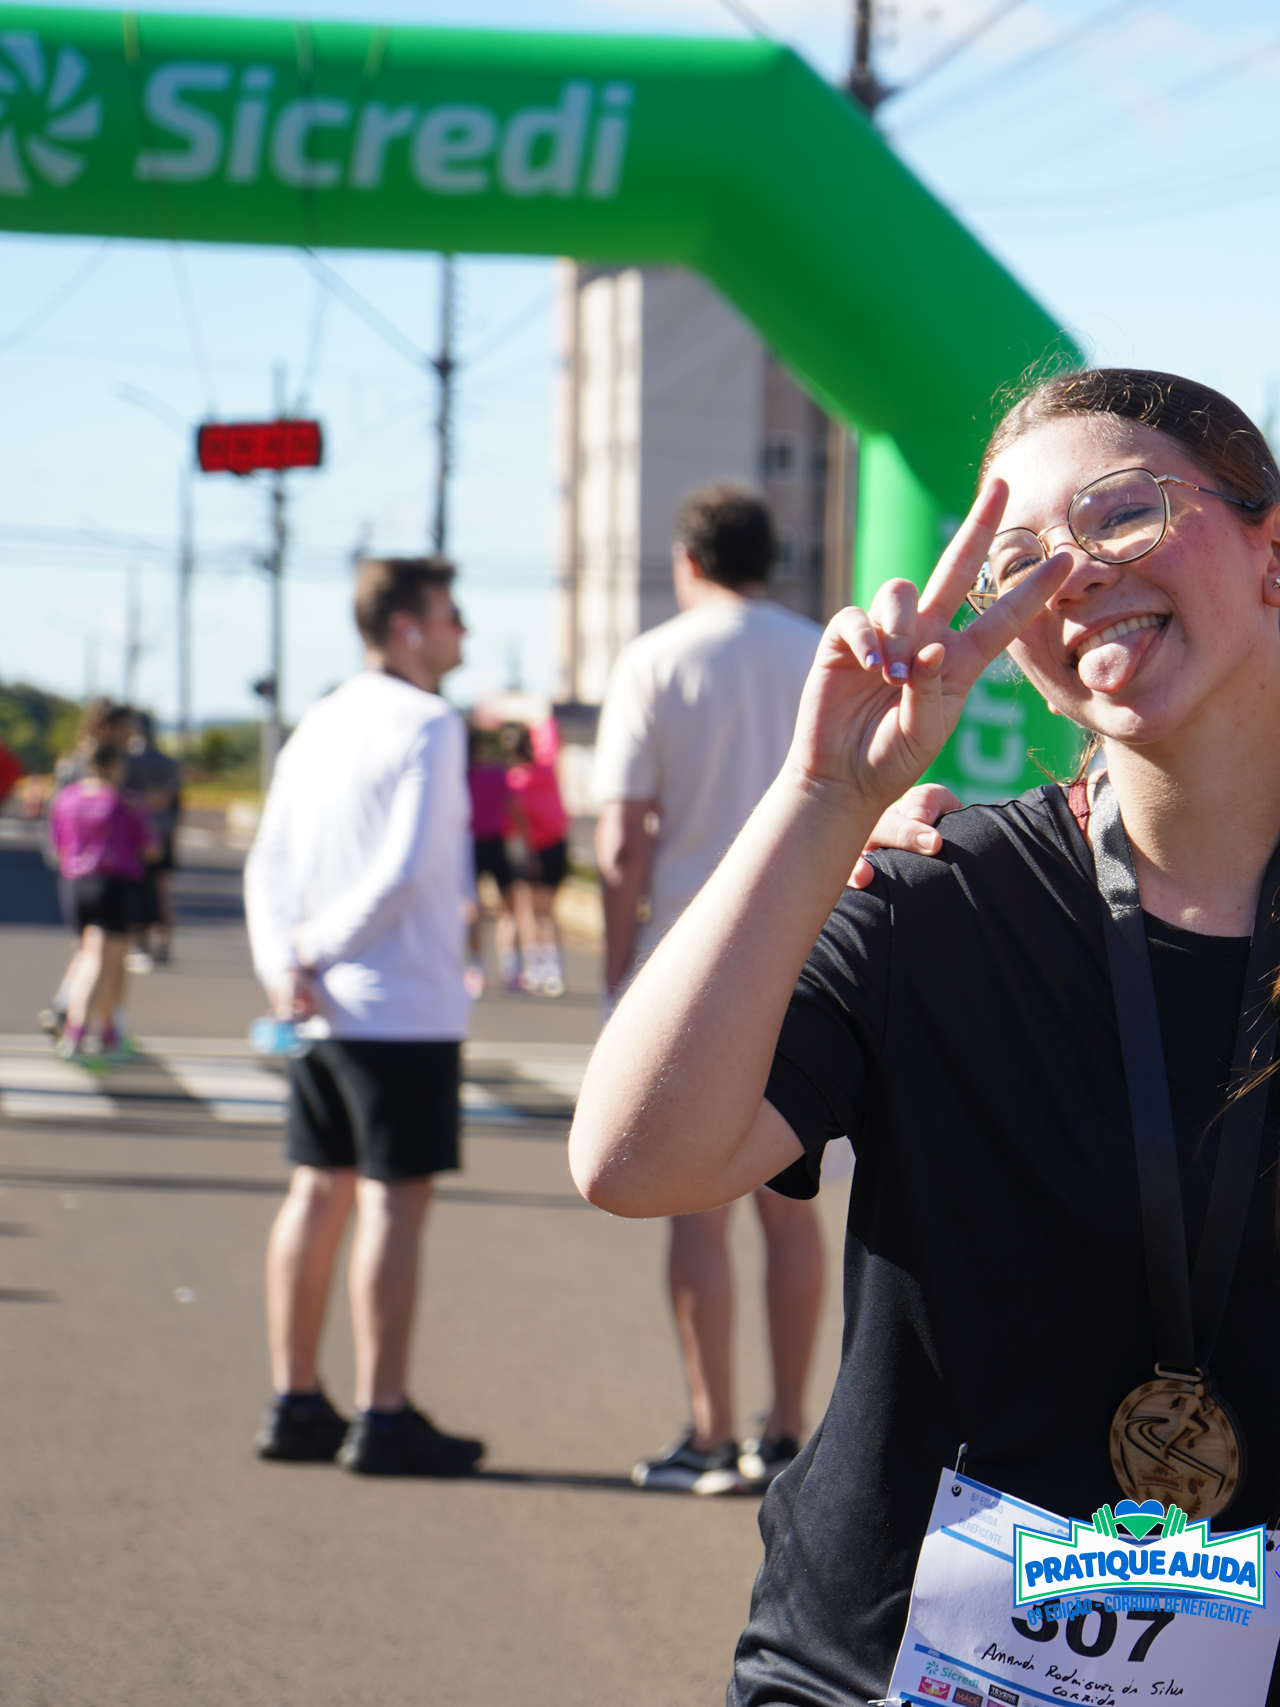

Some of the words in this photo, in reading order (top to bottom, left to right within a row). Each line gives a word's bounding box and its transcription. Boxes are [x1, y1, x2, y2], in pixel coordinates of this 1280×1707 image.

[135, 62, 635, 199] Sicredi
[979, 1495, 1004, 1514] EDIÇÃO
[969, 1507, 998, 1527] CORRIDA
[957, 1518, 1002, 1544] BENEFICENTE
[1012, 1596, 1176, 1663] 307
[940, 1667, 980, 1689] Sicredi
[1150, 1679, 1184, 1696] Silva
[991, 1686, 1018, 1700] TEVERE
